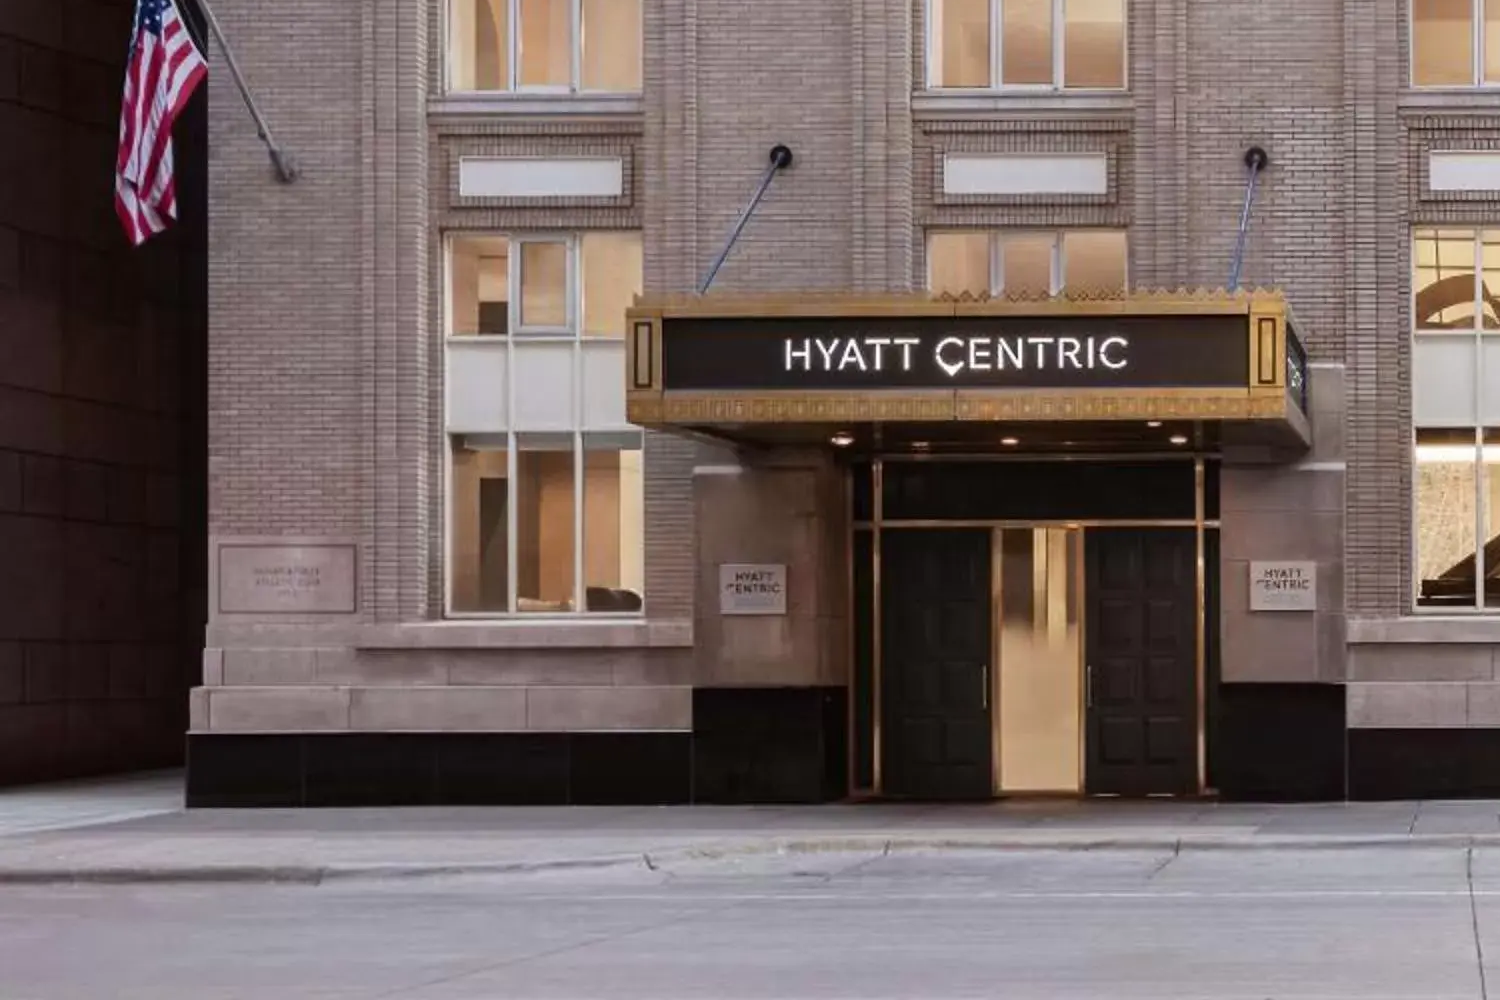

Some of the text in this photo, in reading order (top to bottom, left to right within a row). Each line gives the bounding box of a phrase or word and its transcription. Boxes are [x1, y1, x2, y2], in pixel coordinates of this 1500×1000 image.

[784, 336, 1129, 376] HYATT CENTRIC
[735, 571, 775, 581] HYATT
[1264, 568, 1303, 578] HYATT
